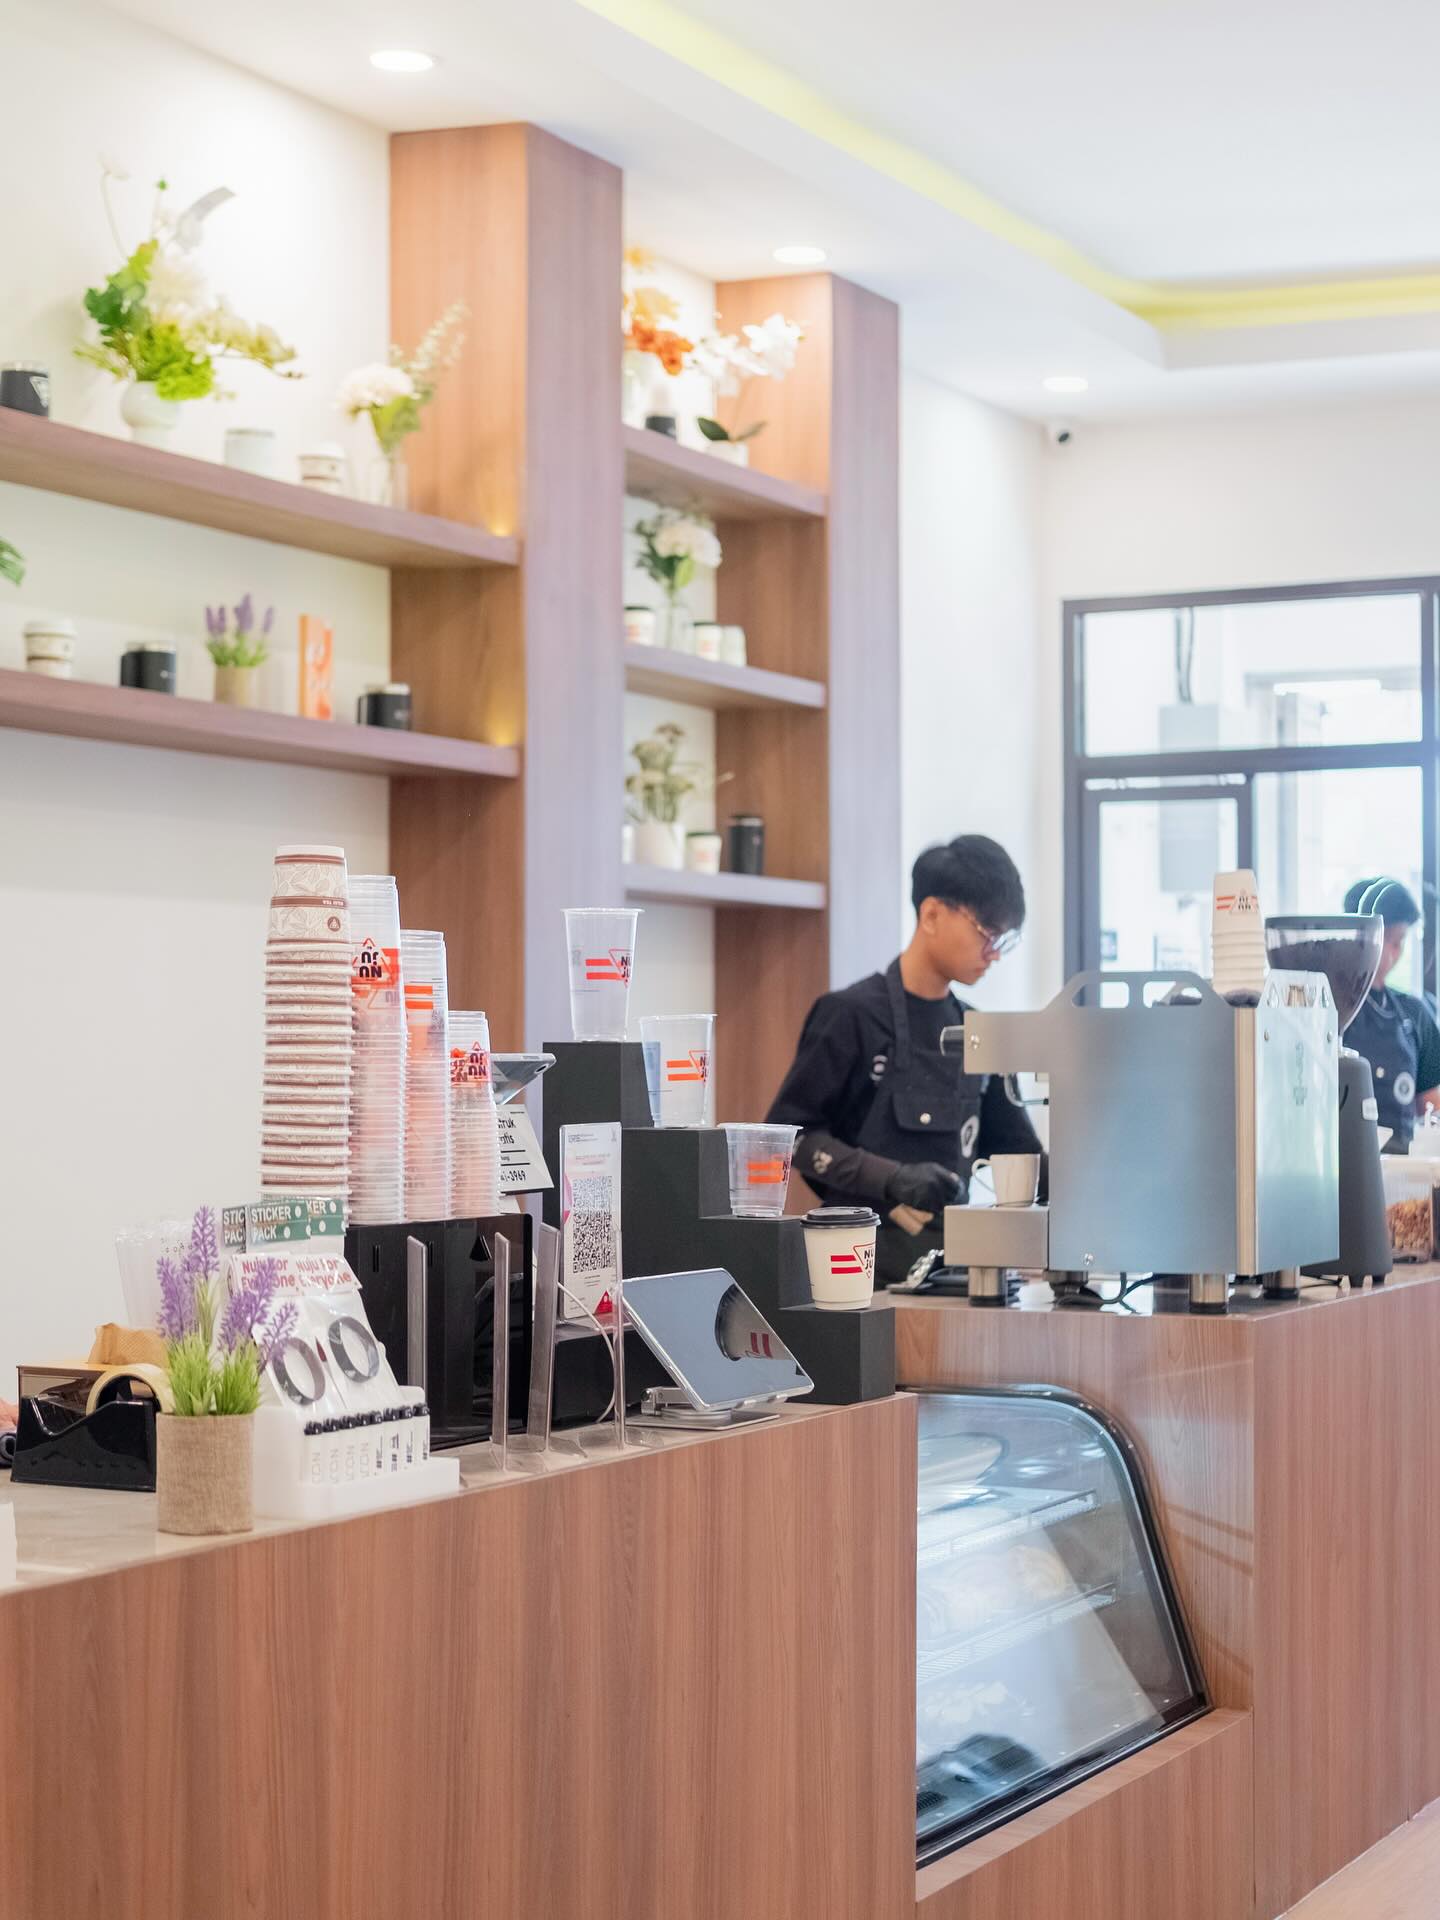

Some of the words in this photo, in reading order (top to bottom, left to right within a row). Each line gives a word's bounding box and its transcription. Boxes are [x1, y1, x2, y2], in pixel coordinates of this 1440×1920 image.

[359, 965, 382, 978] NU
[468, 1064, 487, 1077] NU
[497, 1117, 516, 1129] truk
[251, 1205, 291, 1222] STICKER
[223, 1229, 246, 1245] PAC
[251, 1224, 277, 1242] PACK
